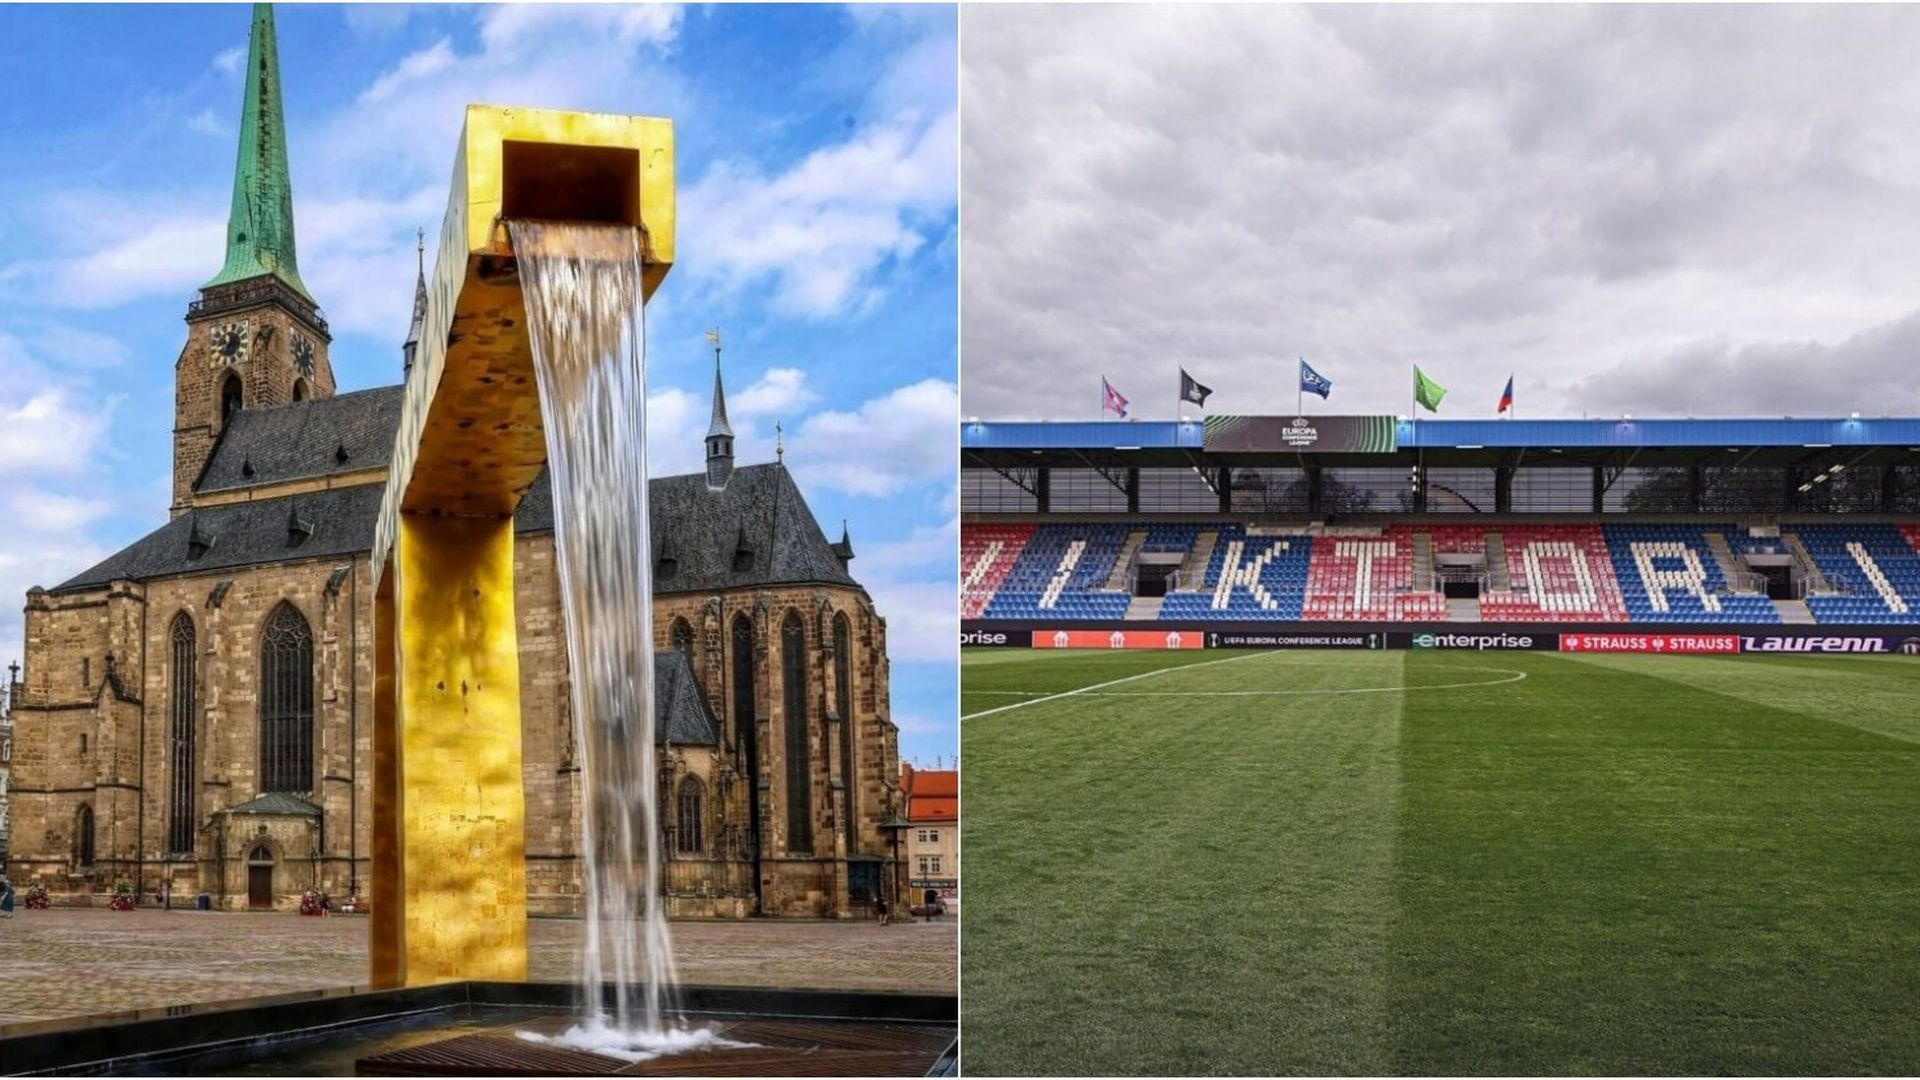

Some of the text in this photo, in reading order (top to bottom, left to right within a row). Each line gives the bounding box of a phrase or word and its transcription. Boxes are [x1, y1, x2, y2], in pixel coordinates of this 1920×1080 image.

[1282, 428, 1317, 436] EUROPA
[1224, 637, 1364, 646] UEFA EUROPA CONFERENCE LEAGUE
[1413, 633, 1533, 650] enterprise
[1583, 637, 1733, 650] STRAUSS STRAUSS
